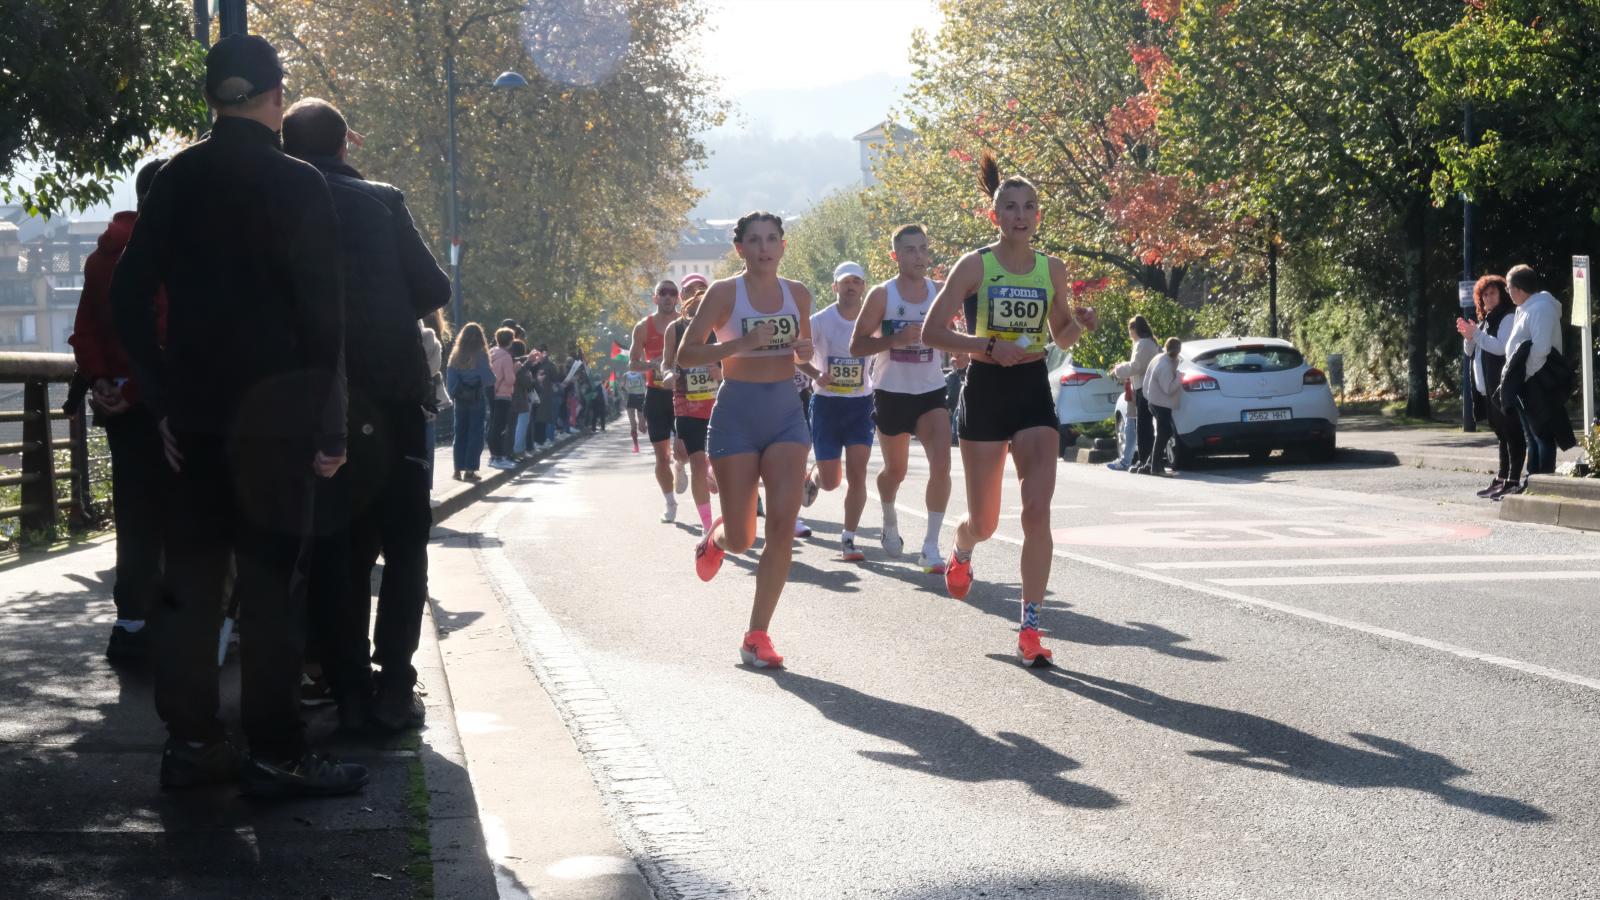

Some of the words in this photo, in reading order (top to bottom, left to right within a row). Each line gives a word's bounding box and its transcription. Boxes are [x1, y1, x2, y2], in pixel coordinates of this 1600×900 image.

[999, 300, 1039, 319] 360
[753, 317, 791, 336] 69
[832, 366, 859, 378] 385
[1248, 411, 1269, 421] 2562
